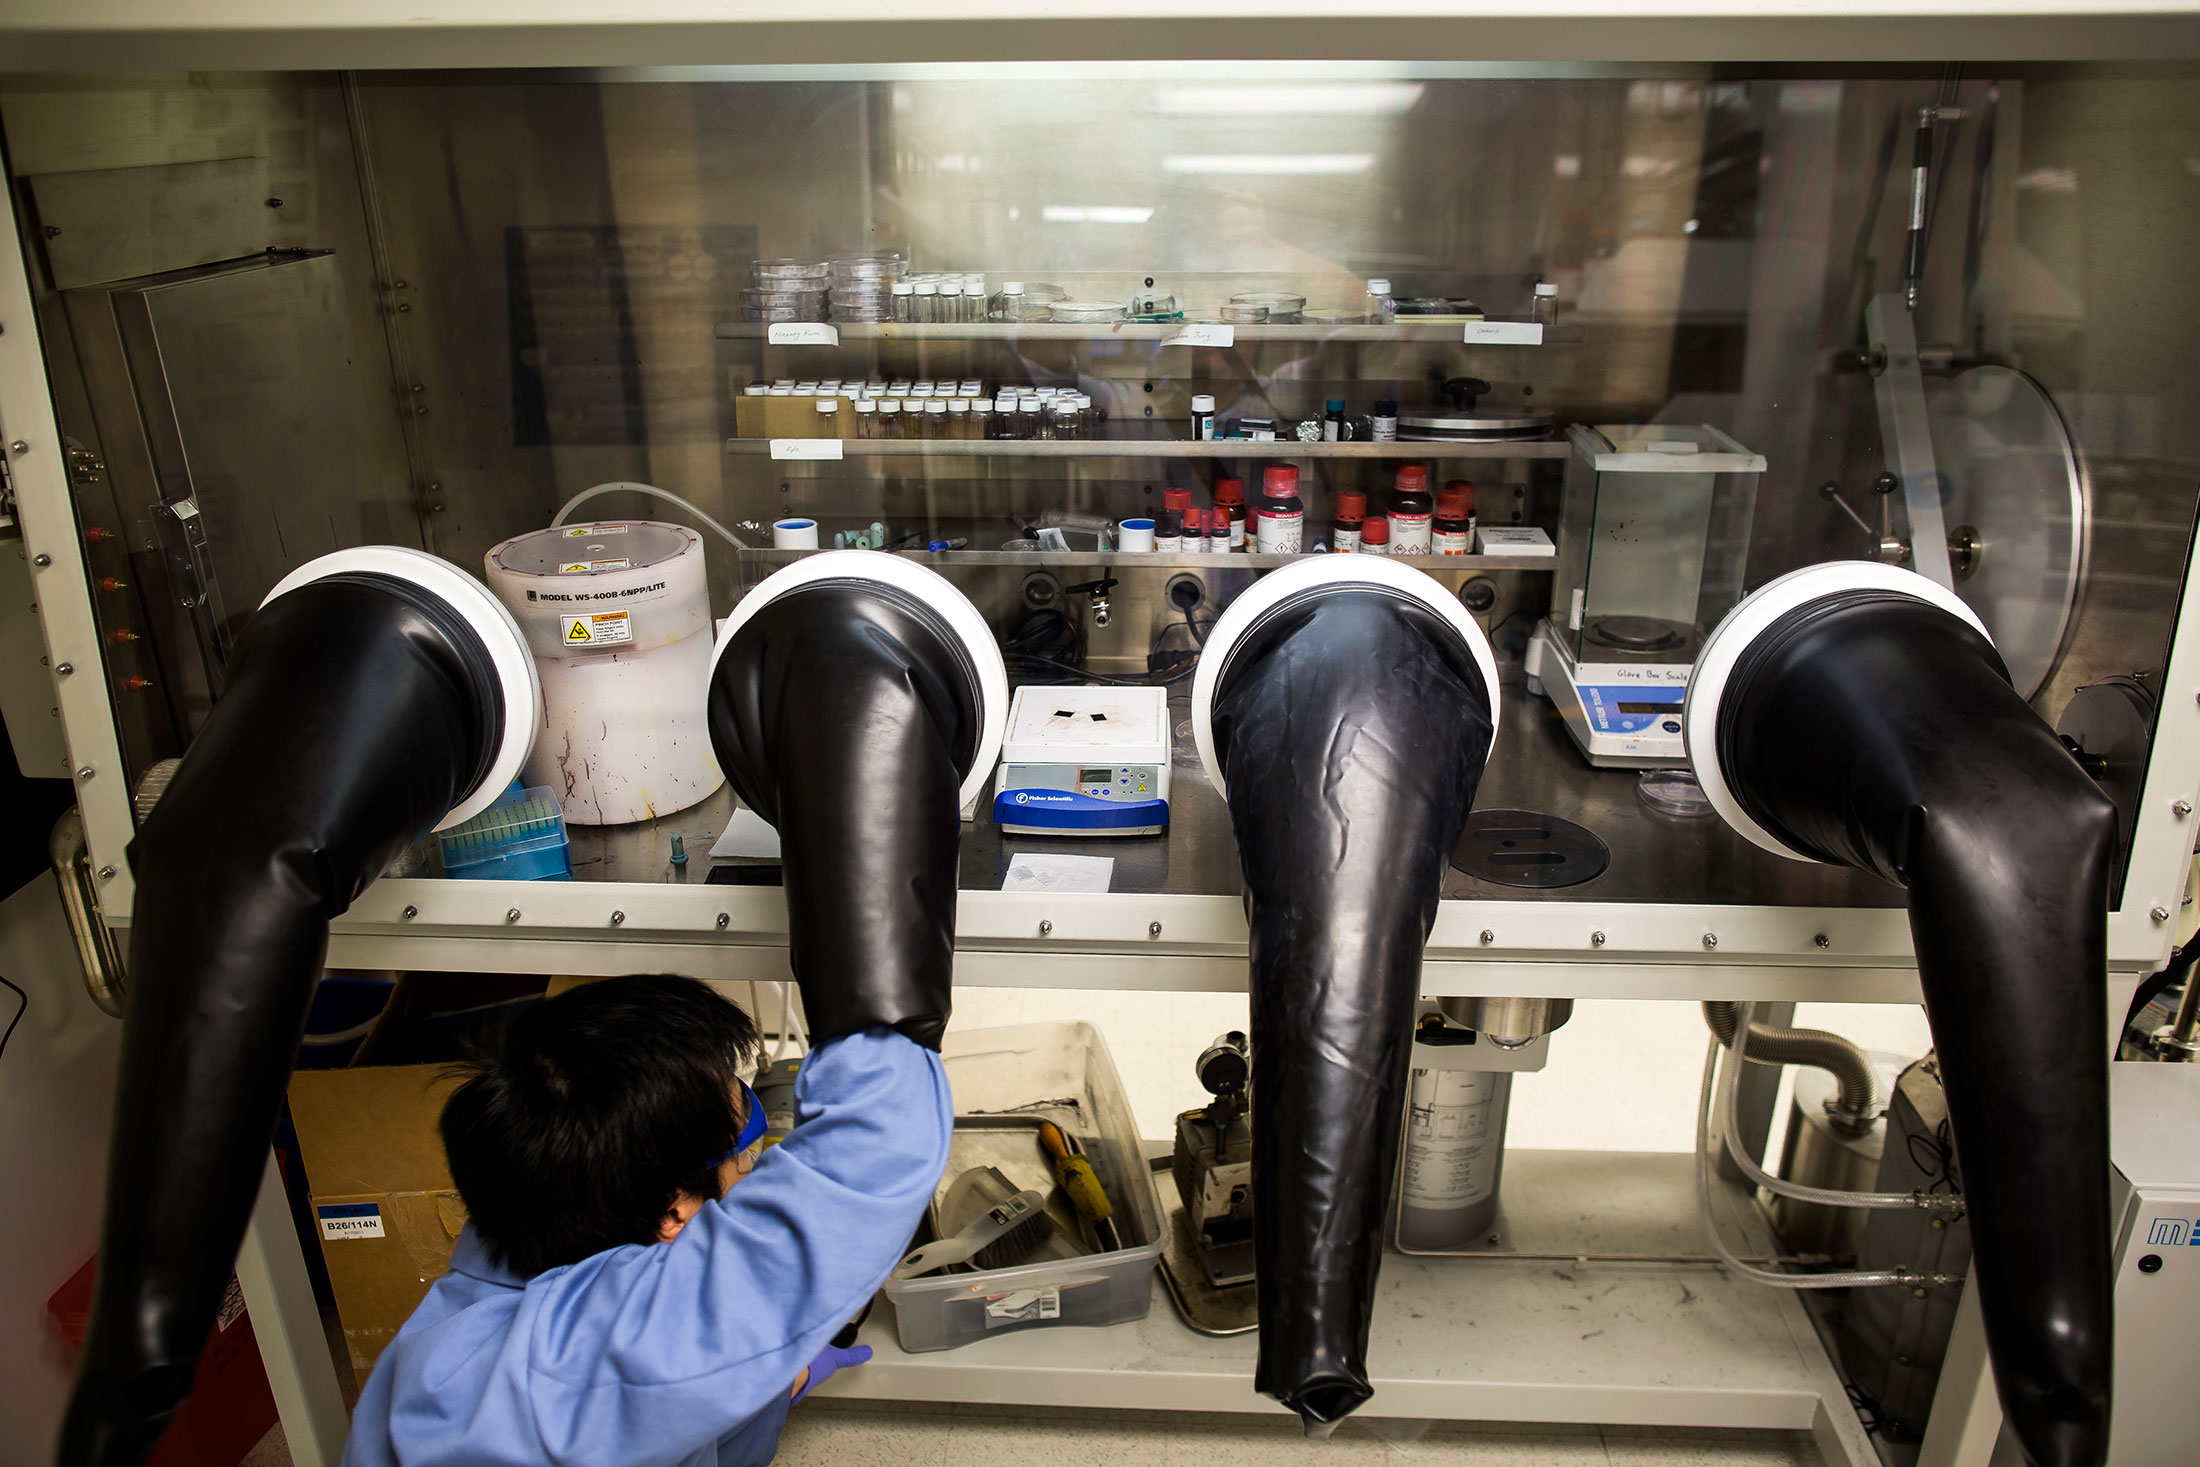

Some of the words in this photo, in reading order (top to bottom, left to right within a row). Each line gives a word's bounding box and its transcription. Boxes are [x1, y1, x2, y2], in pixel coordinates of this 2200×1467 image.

[575, 582, 666, 601] WS-400B-6NPP/LITE
[1617, 669, 1641, 679] Glove
[1666, 671, 1687, 681] Scale
[1590, 687, 1602, 706] TOLEDO
[1596, 706, 1609, 729] METTLER
[327, 1220, 377, 1230] B26/114N
